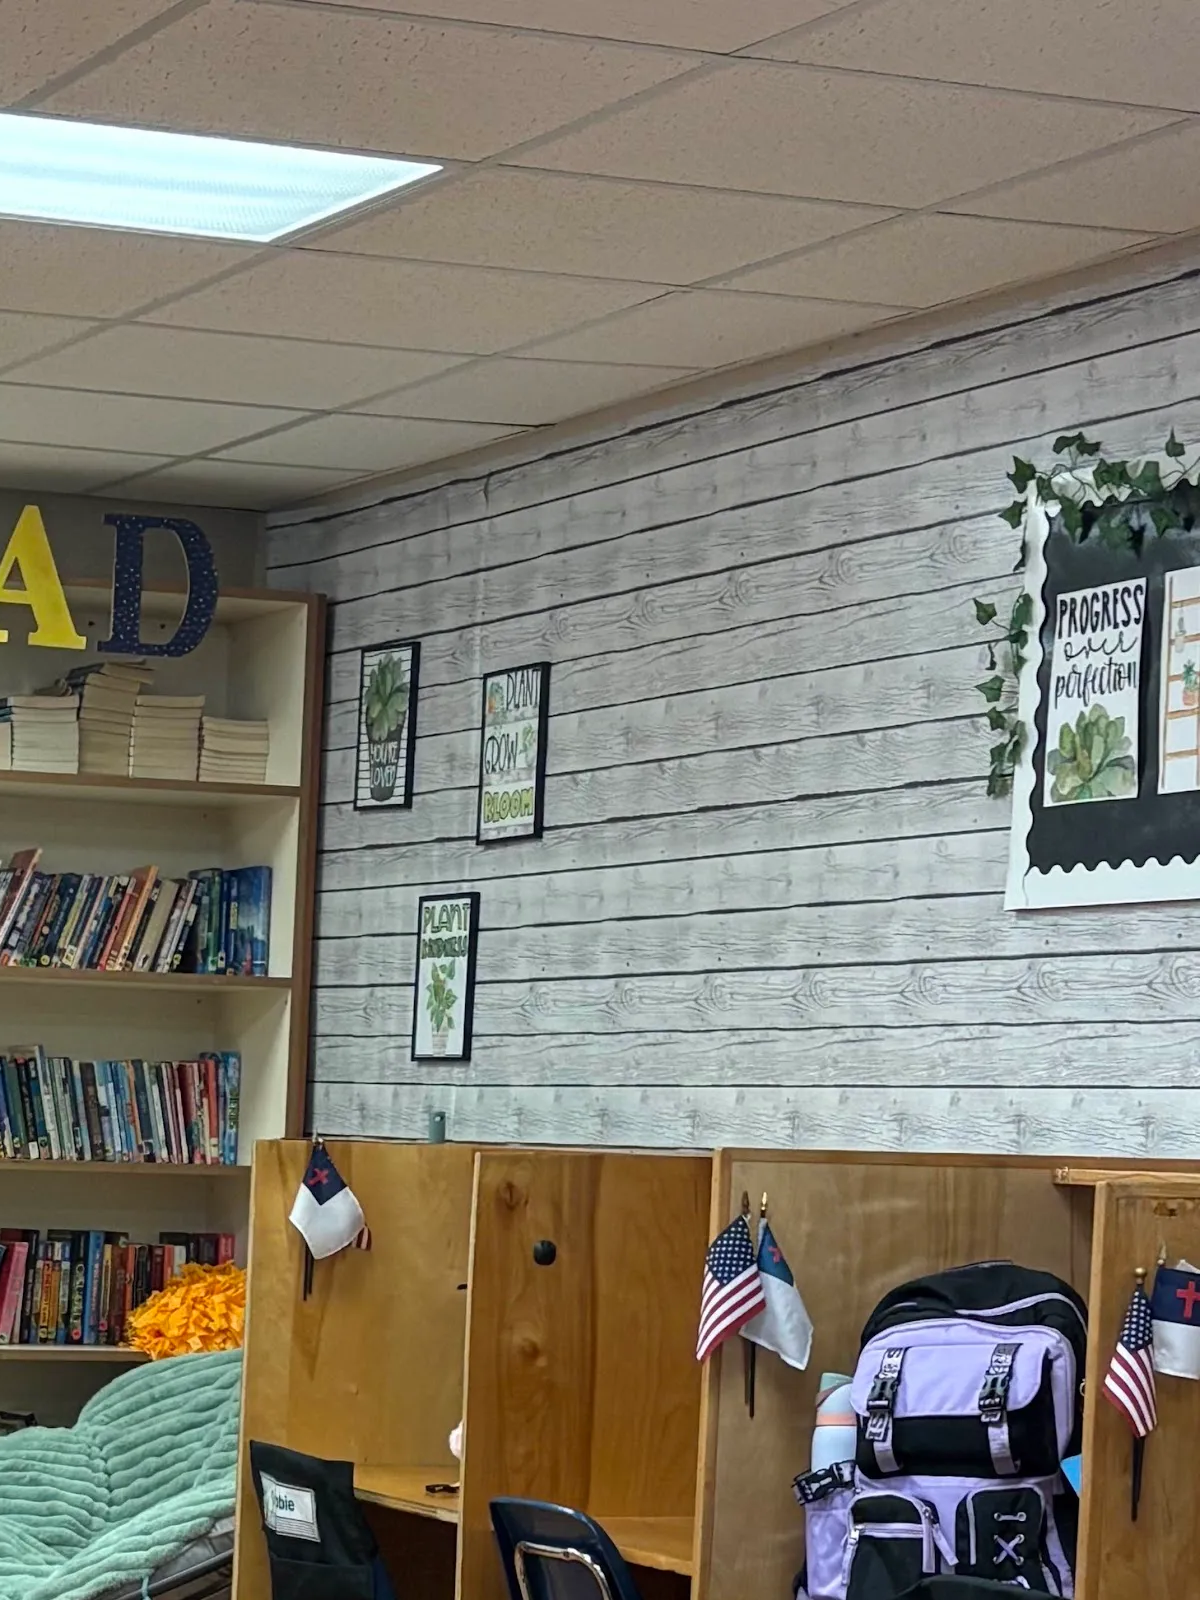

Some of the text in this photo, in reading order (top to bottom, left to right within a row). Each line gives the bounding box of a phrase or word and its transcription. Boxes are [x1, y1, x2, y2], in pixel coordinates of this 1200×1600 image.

[1058, 584, 1144, 640] PROGRESS
[1064, 631, 1138, 661] over
[506, 668, 542, 711] PLANT
[1054, 656, 1137, 710] perfection
[484, 732, 519, 775] GROW
[483, 787, 534, 824] BLOOM
[423, 902, 470, 934] PLANT
